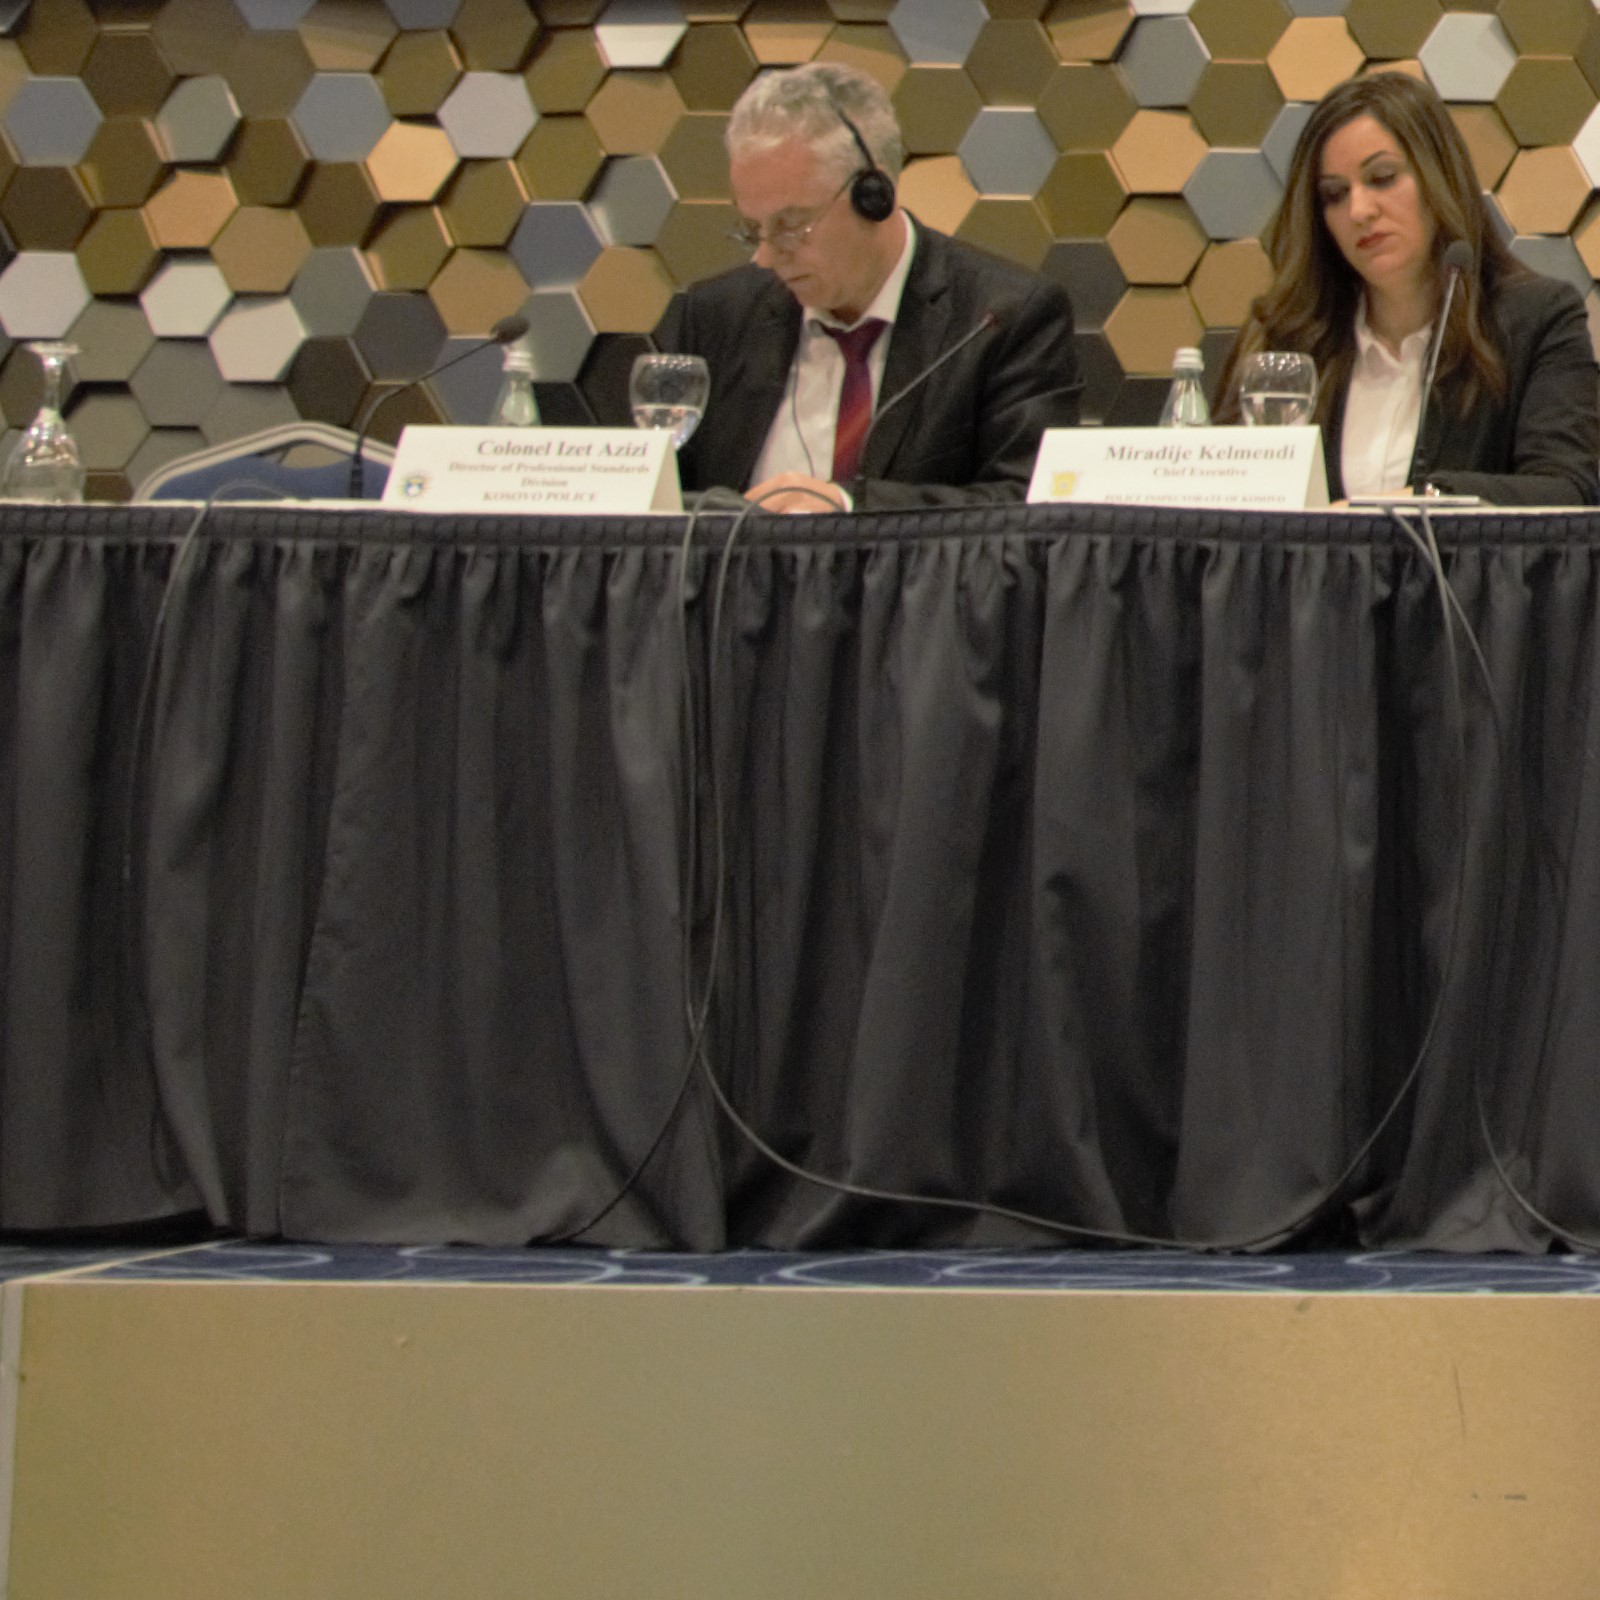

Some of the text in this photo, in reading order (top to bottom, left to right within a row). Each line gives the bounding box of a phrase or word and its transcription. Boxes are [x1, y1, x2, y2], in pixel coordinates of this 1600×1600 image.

[477, 439, 649, 457] Colonel Izet Azizi
[1105, 444, 1297, 464] Miradije Kelmendi
